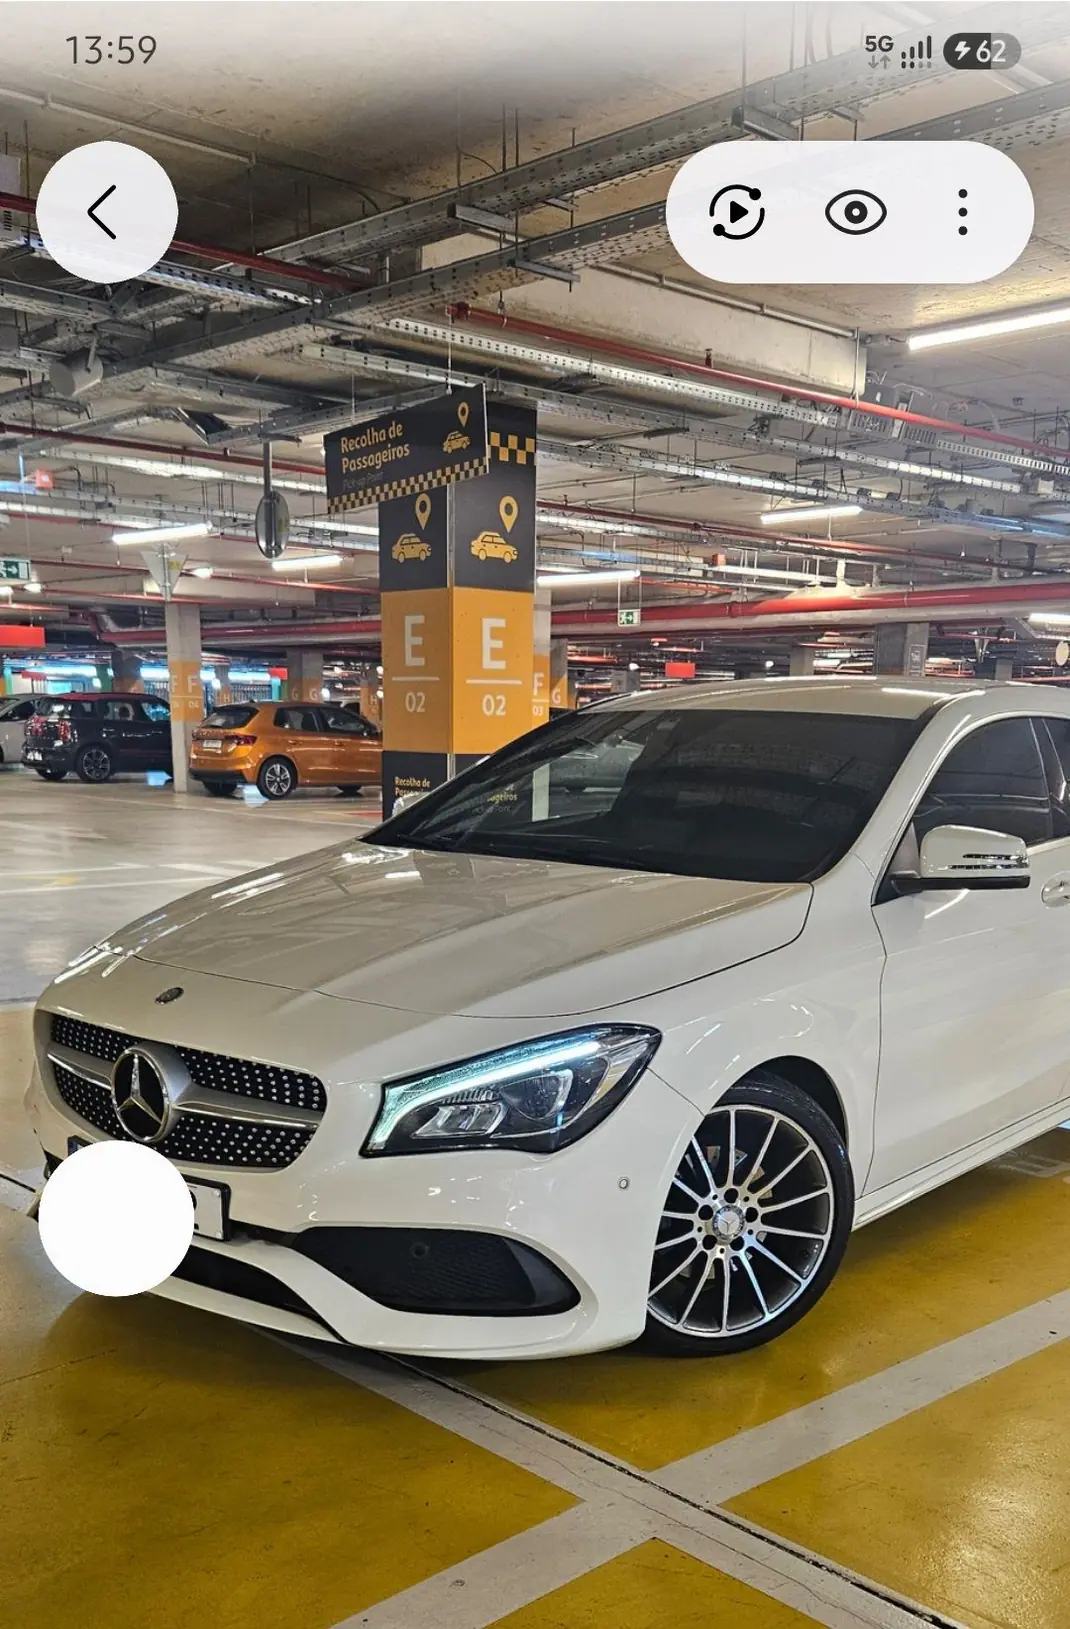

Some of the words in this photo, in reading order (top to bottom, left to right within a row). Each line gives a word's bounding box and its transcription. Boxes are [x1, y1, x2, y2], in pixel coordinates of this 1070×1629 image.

[341, 427, 386, 453] Recolha
[388, 421, 403, 439] de
[341, 443, 410, 474] Passageiros
[404, 614, 425, 666] E
[482, 618, 506, 669] E
[187, 675, 198, 693] F
[533, 672, 544, 696] F
[404, 692, 426, 713] 02
[482, 694, 506, 717] 02
[551, 688, 561, 705] G
[394, 776, 421, 788] Recolha
[422, 777, 431, 789] de
